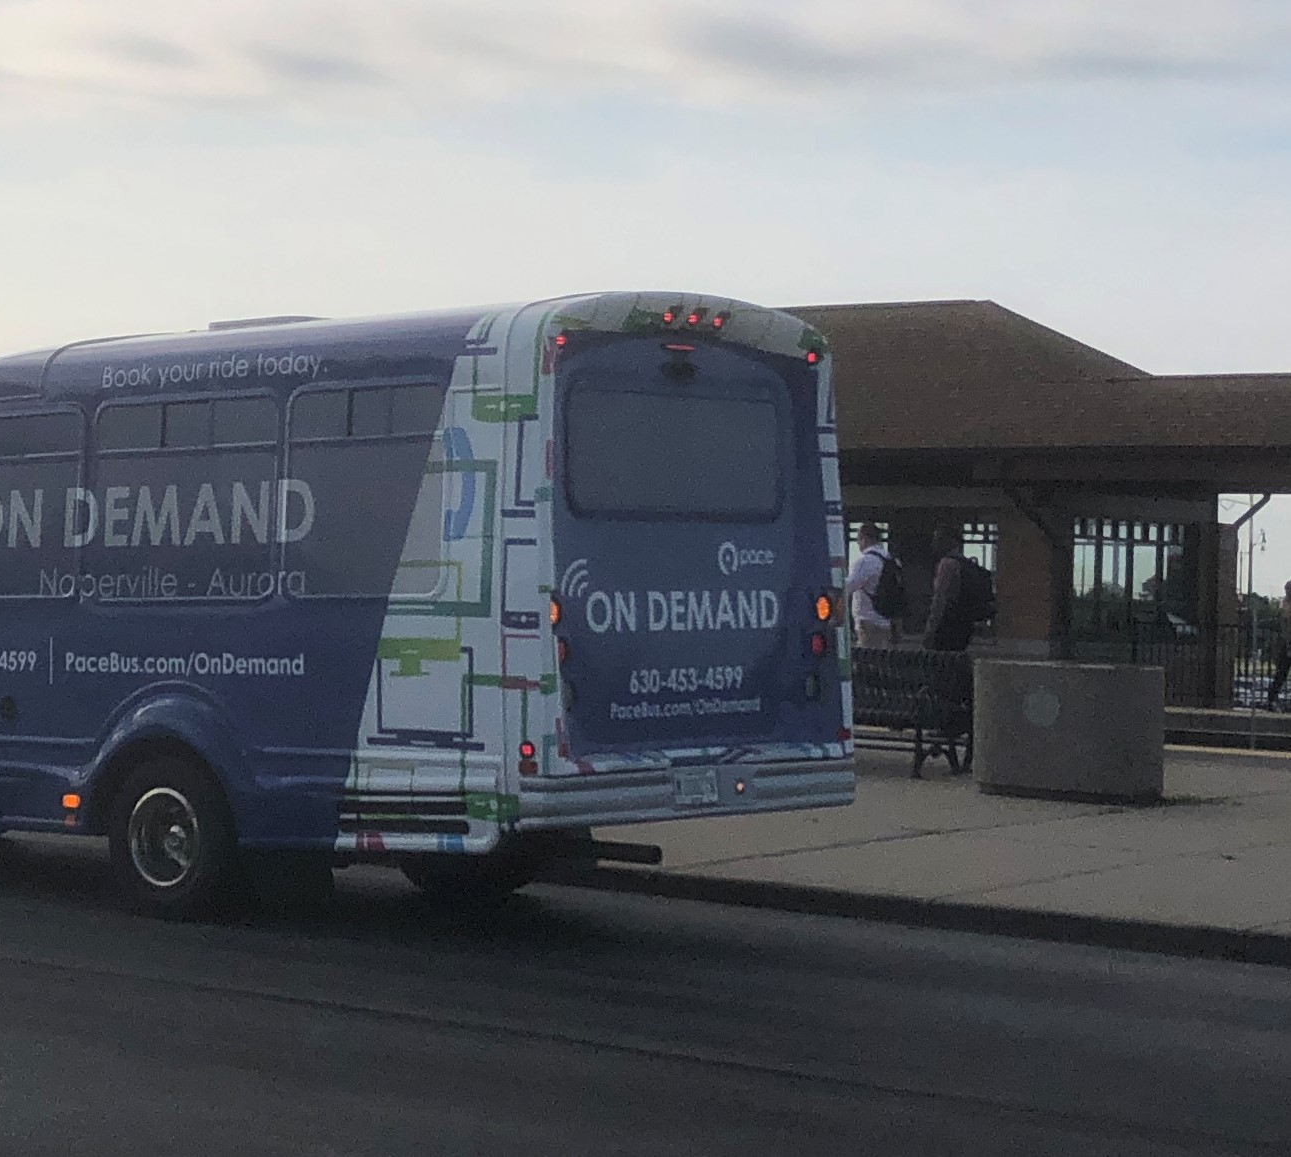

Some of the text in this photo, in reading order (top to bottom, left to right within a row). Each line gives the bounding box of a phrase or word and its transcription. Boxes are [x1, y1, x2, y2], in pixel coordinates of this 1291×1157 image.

[101, 351, 328, 389] Book your ride today.
[64, 478, 315, 548] DEMAND
[739, 549, 775, 566] pace
[39, 565, 178, 603] Naperville
[207, 567, 306, 596] Aurora
[586, 588, 779, 633] ON DEMAND
[64, 651, 305, 677] PaceBus.com/OnDemand
[629, 665, 744, 694] 630-453-4599
